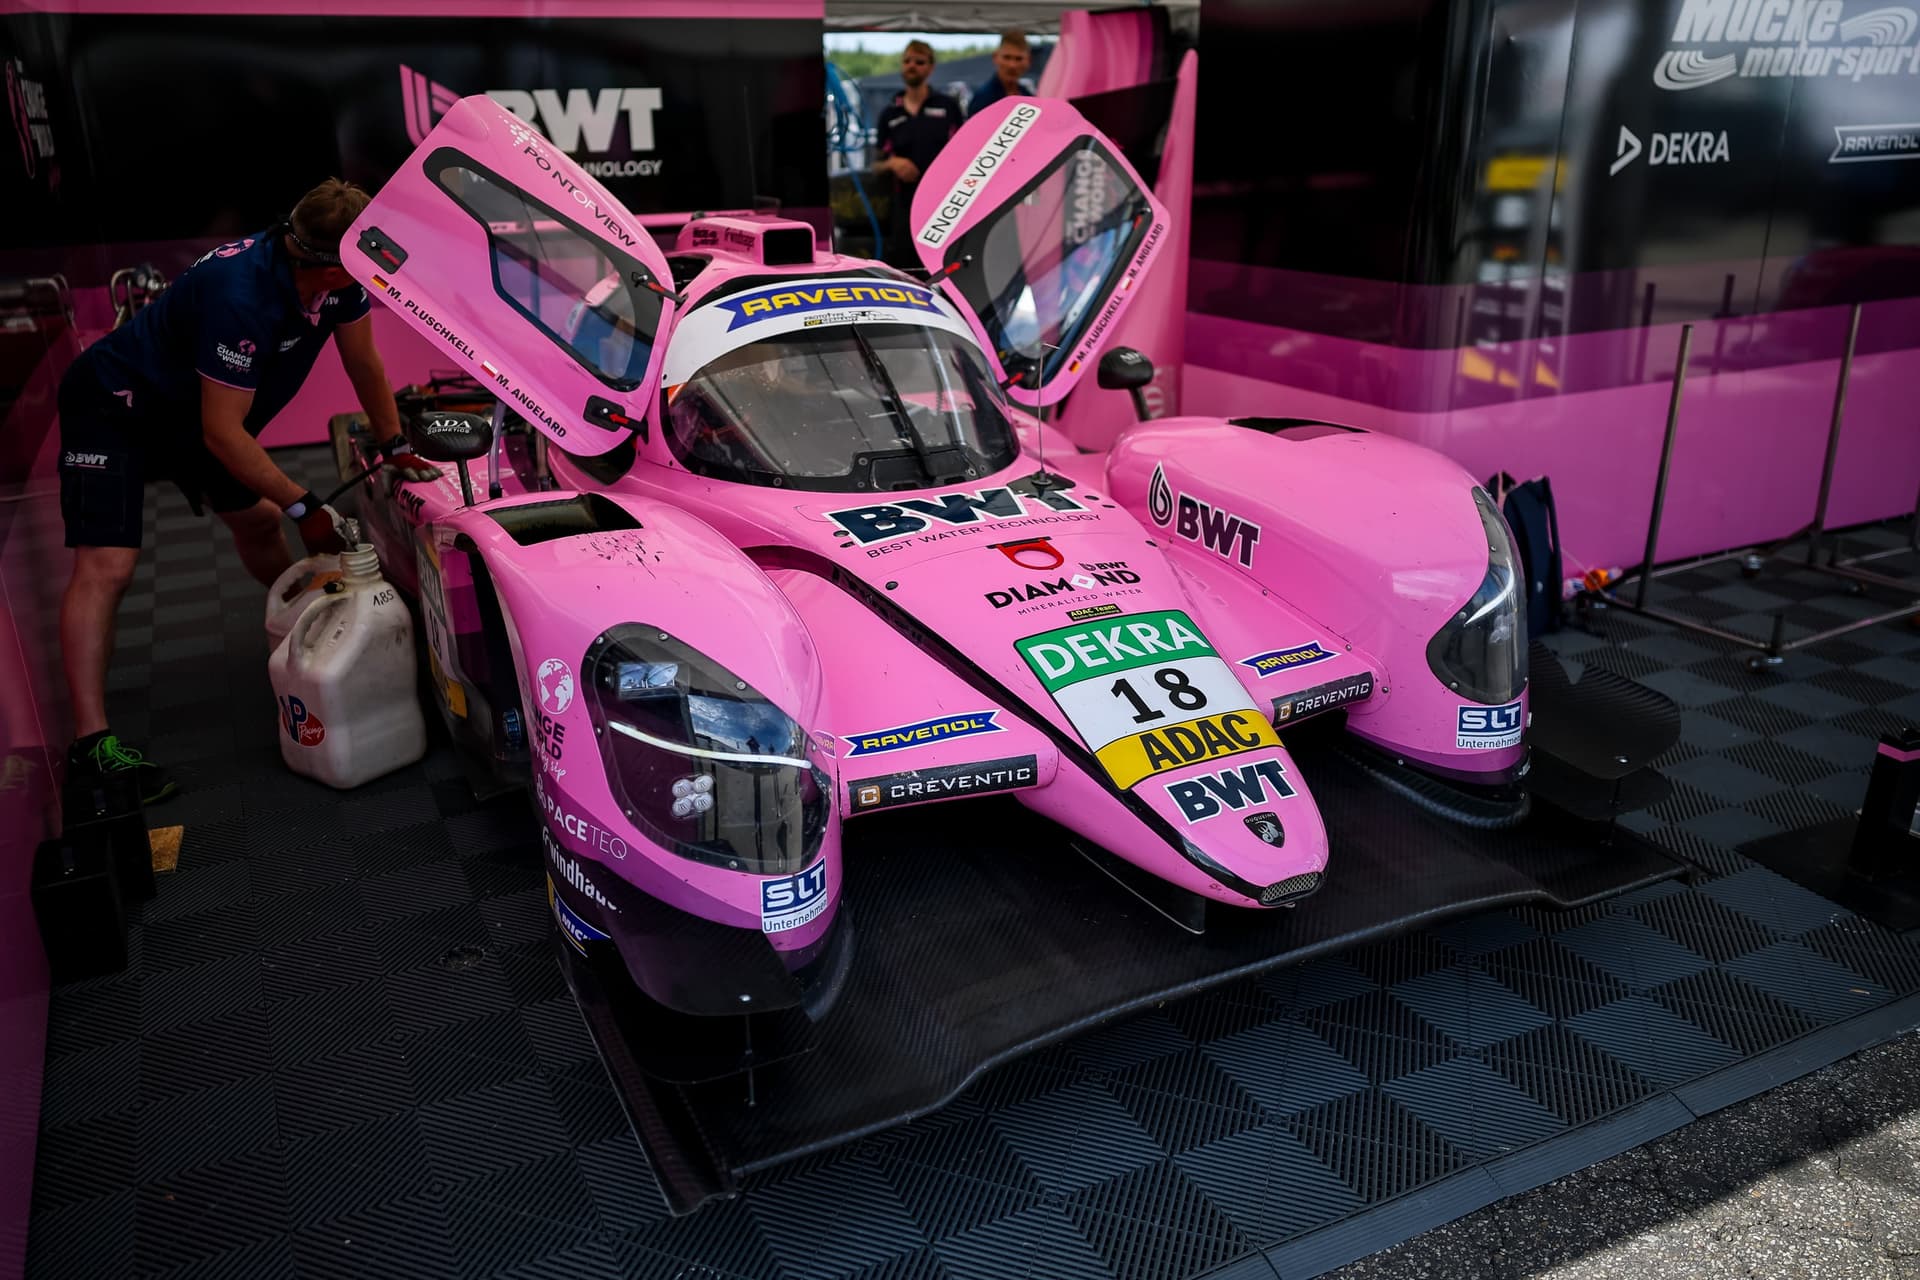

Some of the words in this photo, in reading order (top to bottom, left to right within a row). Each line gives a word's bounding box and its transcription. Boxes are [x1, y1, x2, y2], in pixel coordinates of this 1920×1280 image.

[1649, 130, 1730, 165] DEKRA
[1844, 135, 1918, 152] RAVENOL
[582, 159, 662, 177] NOLOGY
[1136, 223, 1165, 272] ANGELARD
[741, 286, 929, 317] RAVENOL
[387, 286, 402, 302] M.
[404, 300, 475, 361] PLUSCHKELL
[1086, 295, 1124, 349] PLUSCHKELL
[216, 345, 253, 364] CHANGE
[222, 354, 251, 369] WORLD
[496, 373, 510, 391] M.
[511, 388, 567, 439] ANGELARD
[427, 419, 472, 428] ADA
[75, 453, 108, 465] BWT
[820, 486, 1091, 548] BWT
[1175, 491, 1262, 570] BWT
[866, 540, 914, 559] BEST
[917, 525, 982, 543] WATER
[984, 513, 1102, 532] TECHNOLOGY
[1095, 561, 1129, 570] BWT
[1017, 593, 1099, 616] MINERALIZED
[1103, 588, 1144, 598] WATER
[1071, 607, 1095, 617] ADAC
[1094, 604, 1117, 612] Team
[1028, 618, 1210, 681] DEKRA
[1255, 648, 1324, 671] RAVENOL
[1111, 668, 1208, 724] 18
[1295, 682, 1370, 714] CREVENTIC
[1462, 705, 1521, 730] SLT
[862, 718, 986, 750] RAVENOL
[1138, 713, 1261, 771] ADAC
[1163, 758, 1299, 826] BWT
[766, 864, 825, 909] SLT
